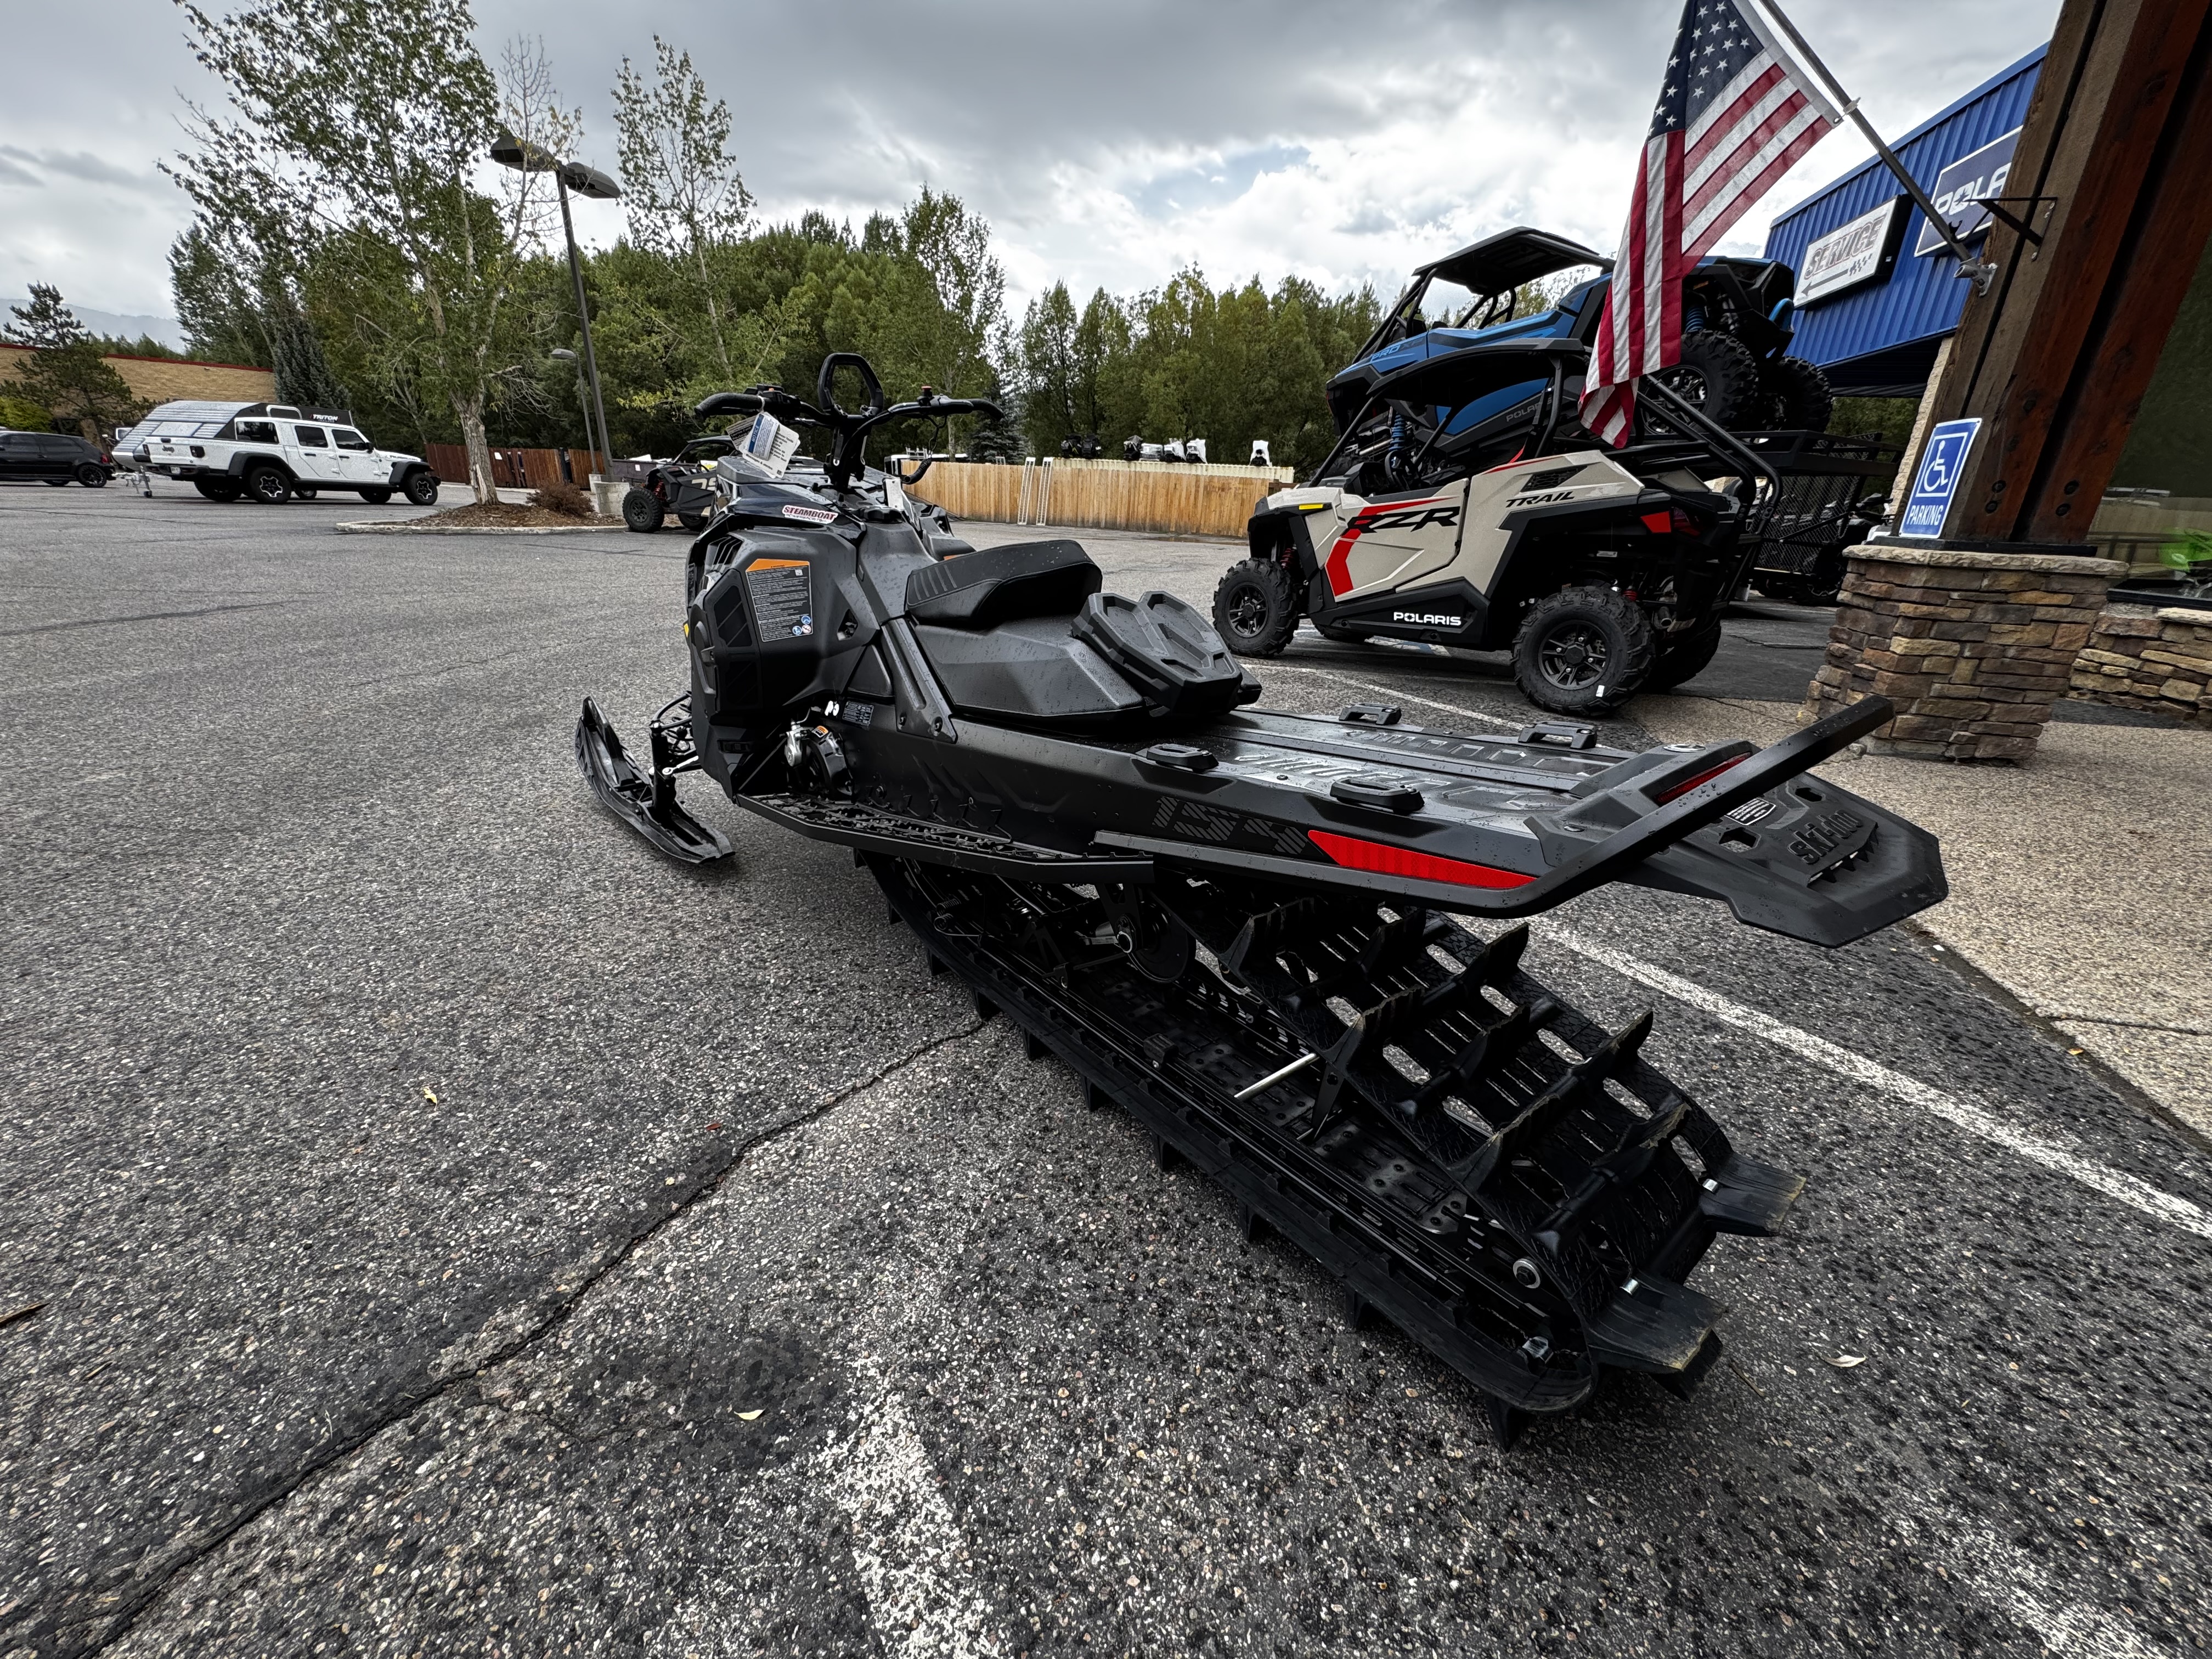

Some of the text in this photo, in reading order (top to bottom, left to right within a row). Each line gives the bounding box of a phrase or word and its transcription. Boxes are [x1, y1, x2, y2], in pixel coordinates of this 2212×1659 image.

[1804, 214, 1888, 280] SERVICE
[1371, 344, 1401, 362] PRO
[752, 426, 760, 443] NOTICE
[1506, 492, 1575, 508] TRAIL
[783, 506, 836, 521] STEAMBOAT
[1340, 506, 1460, 537] RZR
[1906, 505, 1944, 526] PARKING
[1393, 612, 1462, 627] POLARIS
